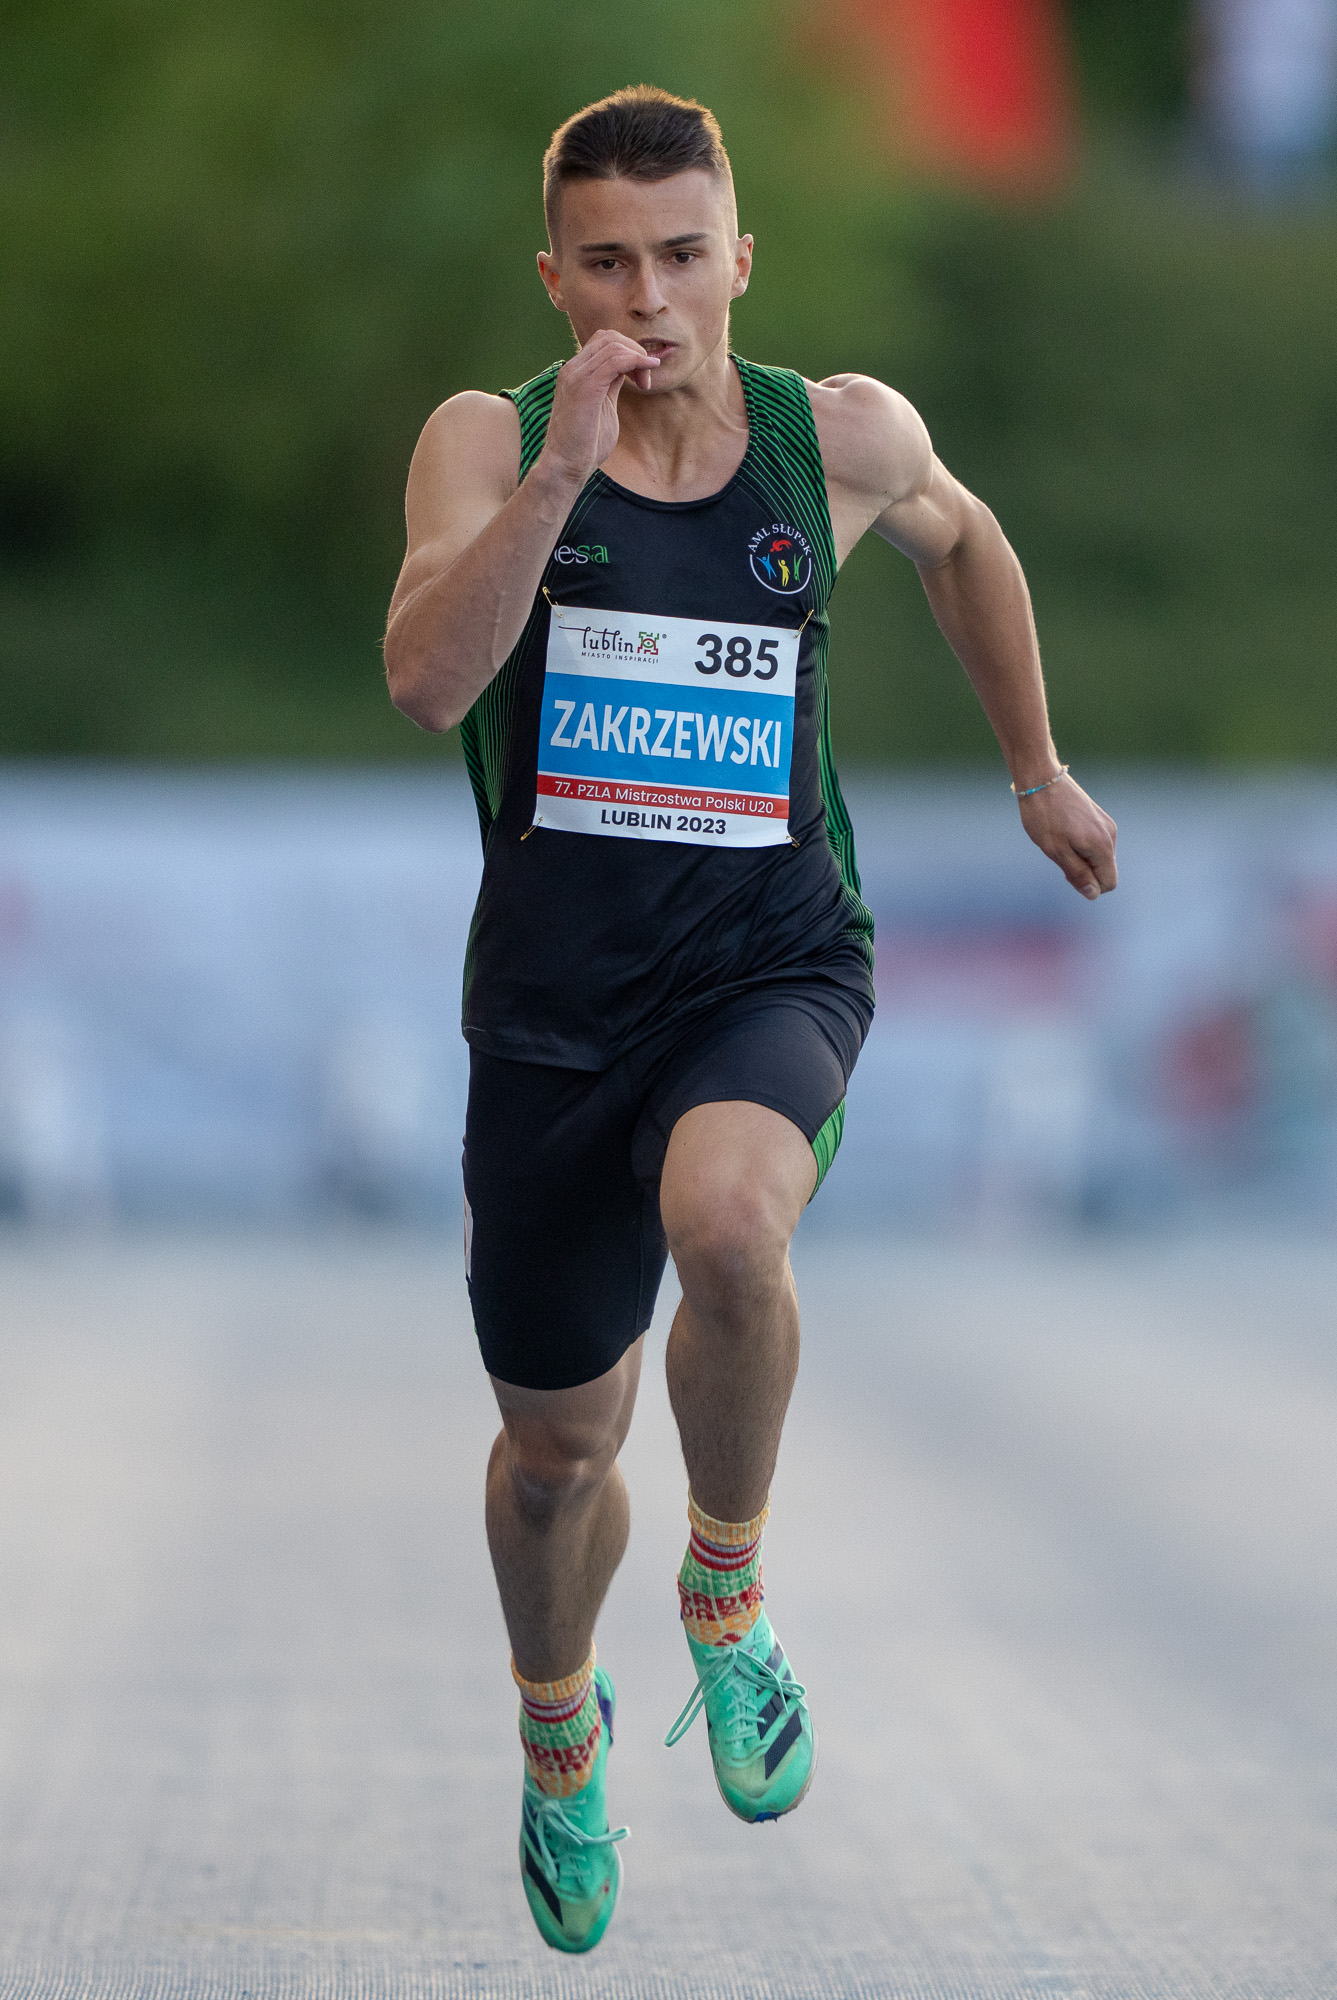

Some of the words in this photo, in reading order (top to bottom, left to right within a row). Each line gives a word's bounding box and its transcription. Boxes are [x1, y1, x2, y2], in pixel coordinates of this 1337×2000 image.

[747, 527, 771, 553] AML
[772, 523, 813, 556] SŁUPSK
[580, 651, 611, 660] MIASTO
[614, 655, 659, 665] INSPIRACJI
[694, 633, 779, 681] 385
[549, 699, 782, 770] ZAKRZEWSKI
[554, 780, 574, 796] 77.
[577, 784, 612, 800] PZLA
[615, 787, 702, 808] Mistrzostwa
[705, 795, 746, 812] Polski
[748, 799, 774, 814] U20
[600, 809, 672, 830] LUBLIN
[676, 815, 727, 835] 2023
